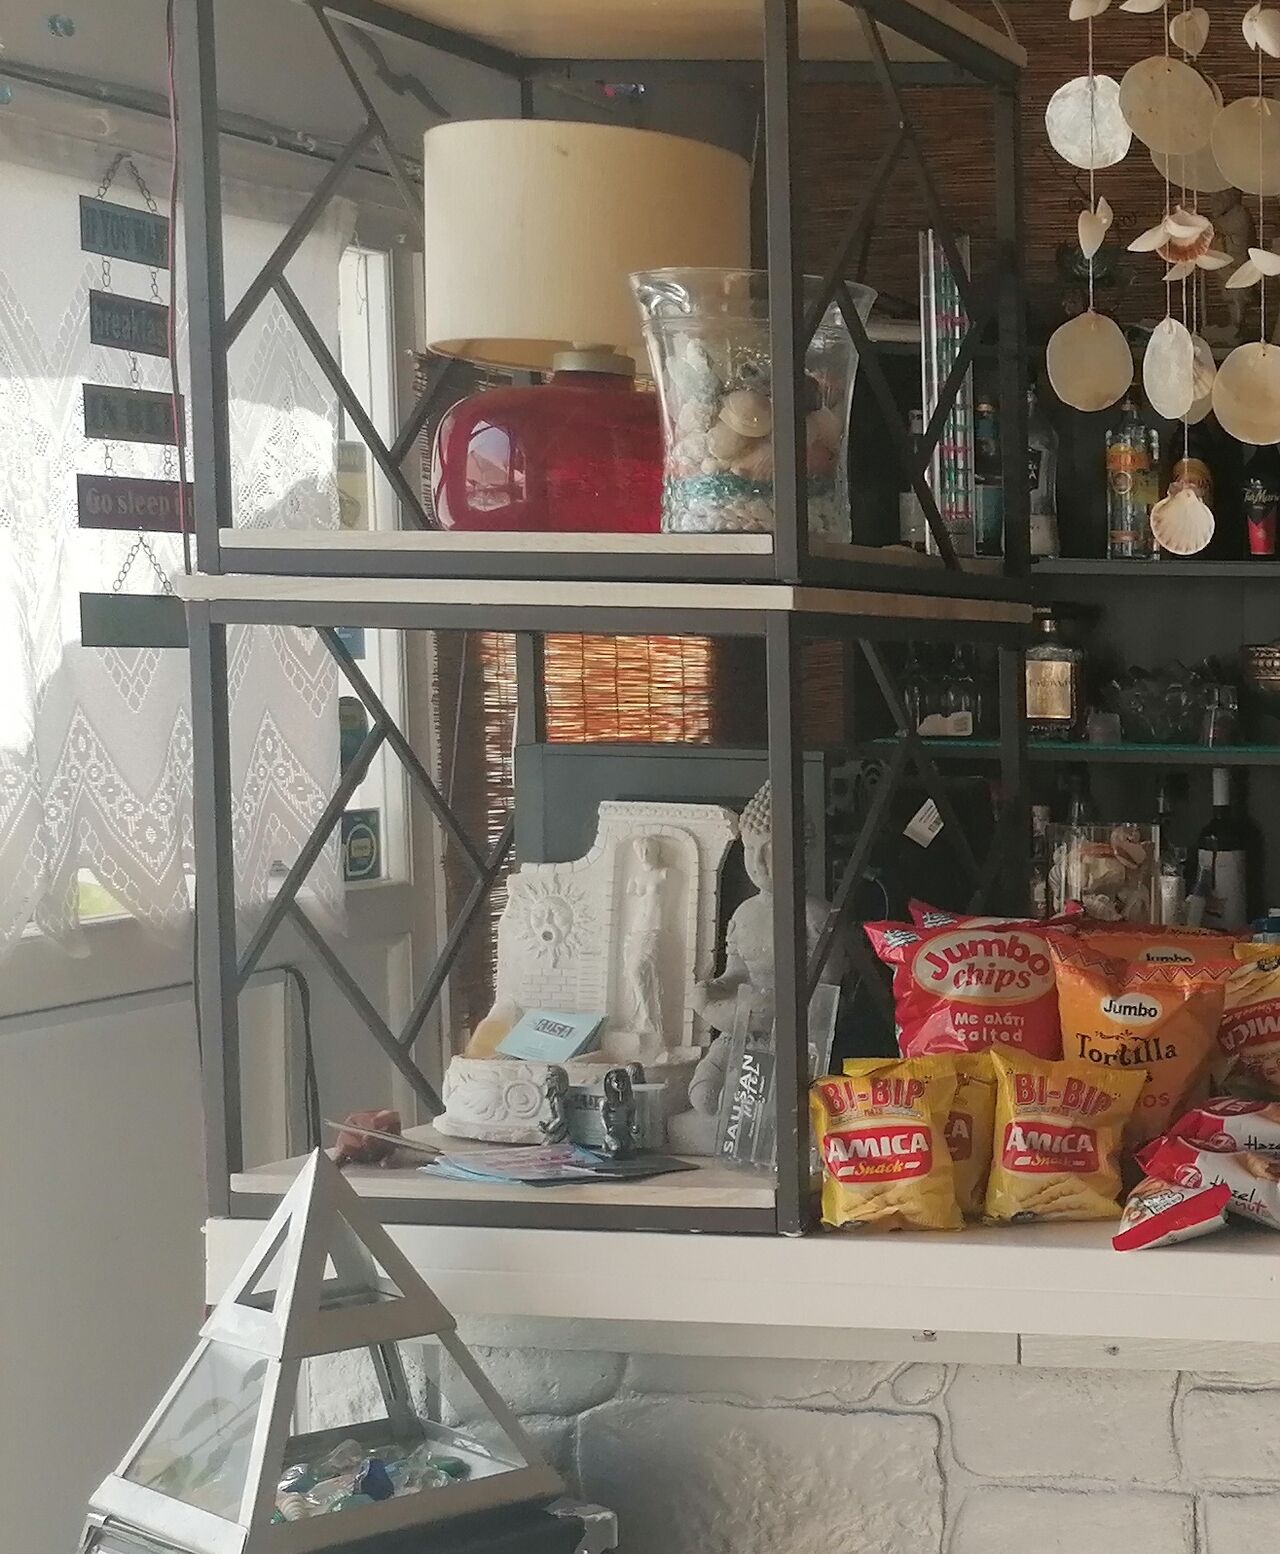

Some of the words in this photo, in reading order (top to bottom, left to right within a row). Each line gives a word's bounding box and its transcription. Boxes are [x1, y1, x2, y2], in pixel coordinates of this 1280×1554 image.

[86, 486, 112, 515] Go
[116, 488, 170, 520] sleep
[923, 935, 1050, 980] Jumbo
[953, 962, 1032, 993] chips
[984, 1012, 1025, 1026] αλάτι
[1103, 1000, 1158, 1018] Jumbo
[956, 1029, 1023, 1042] Salted
[1076, 1032, 1177, 1066] Tortilla
[723, 1055, 754, 1153] SAUSAN
[820, 1077, 925, 1117] BI-BIP
[1014, 1073, 1113, 1116] BI-BIP
[827, 1132, 929, 1163] AMICA
[1006, 1126, 1095, 1154] AMICA
[854, 1160, 906, 1176] Snack
[1209, 1173, 1256, 1203] Hzel
[1235, 1199, 1267, 1216] nut
